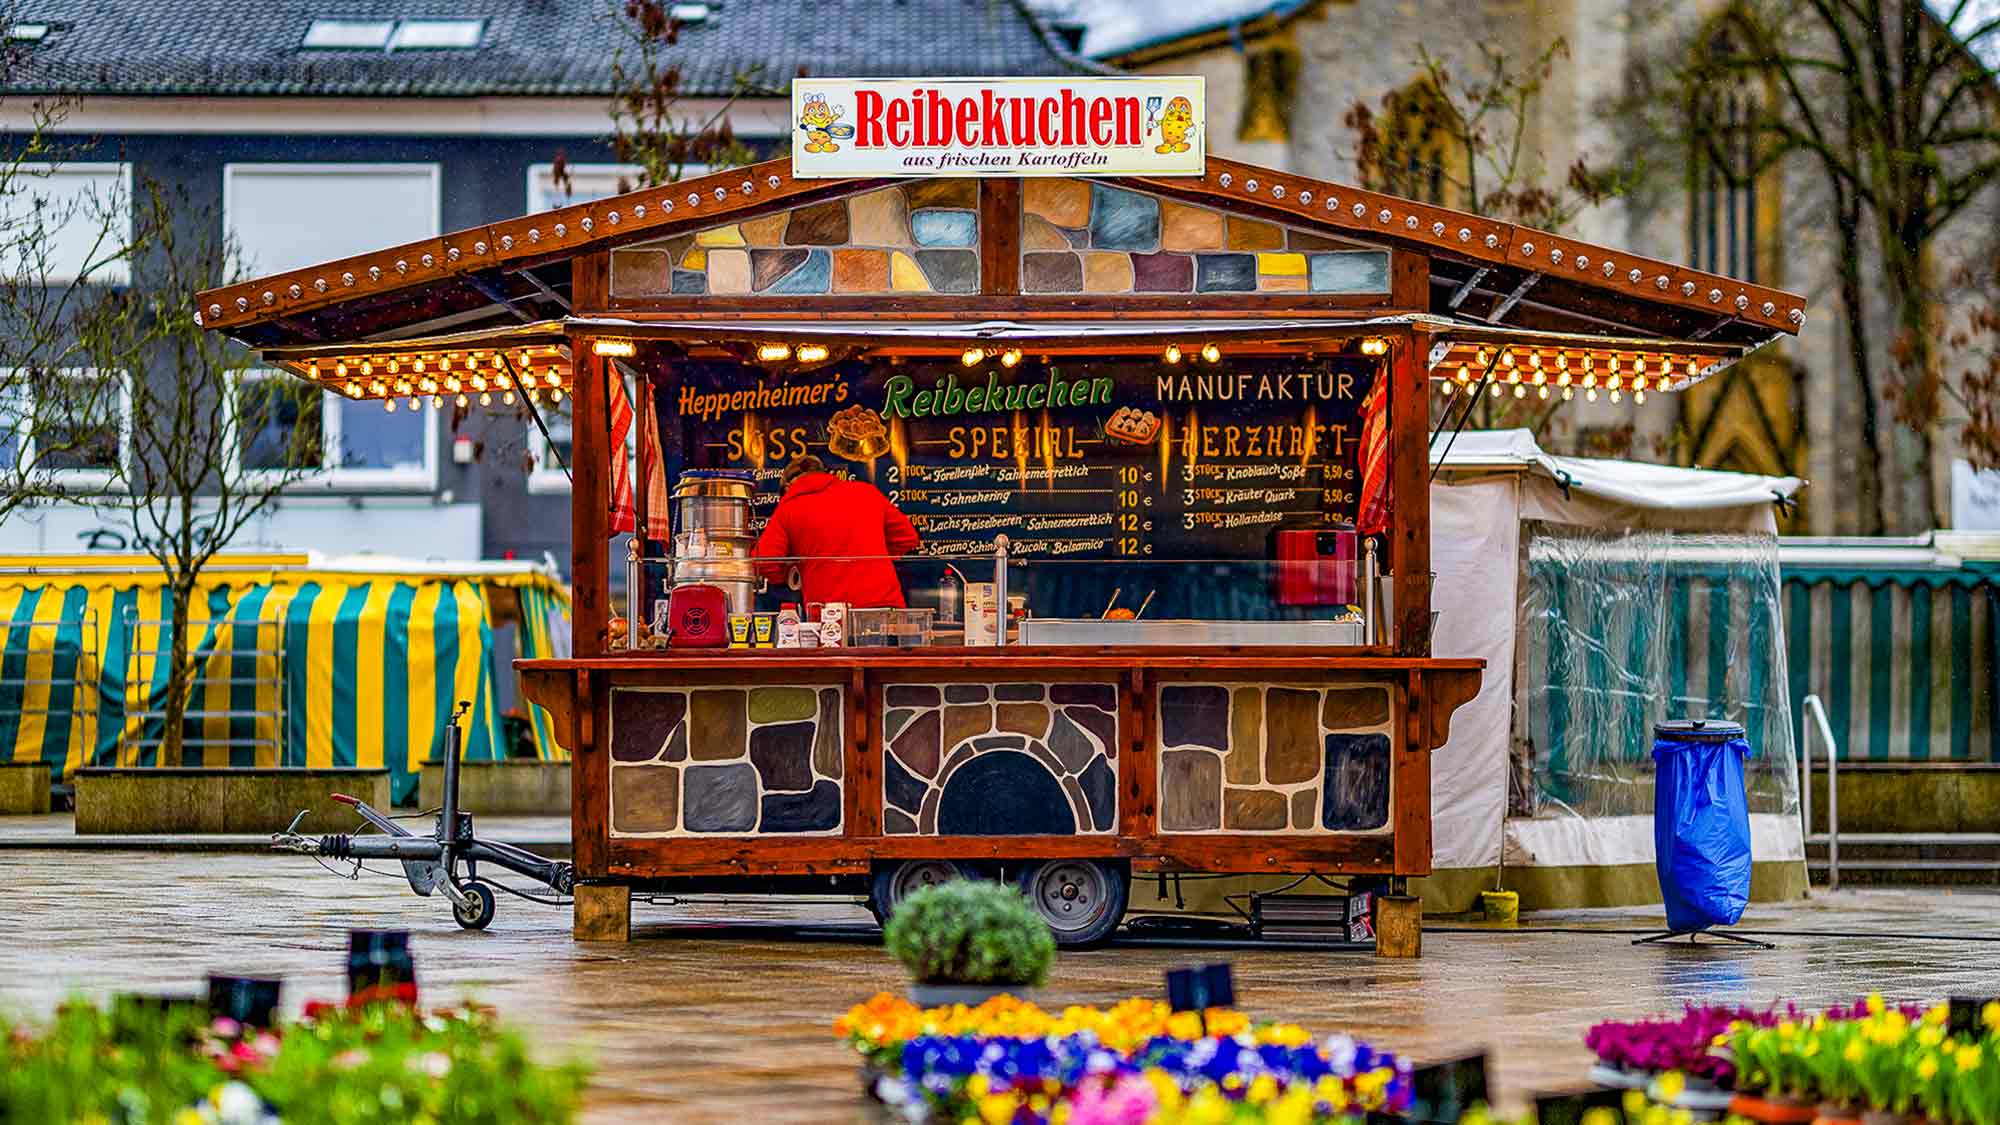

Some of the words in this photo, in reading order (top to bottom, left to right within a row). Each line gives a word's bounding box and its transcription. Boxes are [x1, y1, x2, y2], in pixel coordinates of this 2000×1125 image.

[854, 88, 1145, 149] Reibekuchen
[903, 154, 933, 168] aus
[936, 152, 1011, 170] frischen
[1018, 151, 1109, 170] Kartoffeln
[679, 373, 849, 421] Heppenheimer's
[880, 367, 1114, 420] Reibekuchen
[1157, 374, 1355, 401] MANUFAKTUR
[948, 426, 1084, 459] SPEZIAL
[1181, 424, 1347, 457] HERZHAFT
[887, 466, 900, 483] 2
[1119, 467, 1139, 484] 10
[1143, 472, 1153, 482] €
[1183, 465, 1195, 482] 3
[1226, 463, 1280, 481] Knoblauch
[1324, 465, 1343, 480] 5,50
[1344, 469, 1354, 480] €
[941, 490, 1011, 507] Sahnehering
[1119, 490, 1139, 508] 10
[1143, 496, 1153, 507] €
[1183, 488, 1195, 506] 3
[1264, 487, 1296, 504] Quark
[1324, 488, 1343, 503] 5,50
[1344, 493, 1354, 504] €
[929, 516, 960, 532] Lachs
[1119, 514, 1139, 532] 12
[1143, 521, 1153, 532] €
[1183, 512, 1195, 530] 3
[1225, 511, 1283, 529] Hollandaise
[929, 542, 967, 556] Serrano
[1011, 541, 1047, 555] Rucola
[1051, 540, 1104, 555] Balsamico
[1119, 537, 1139, 555] 12
[1143, 544, 1153, 555] €
